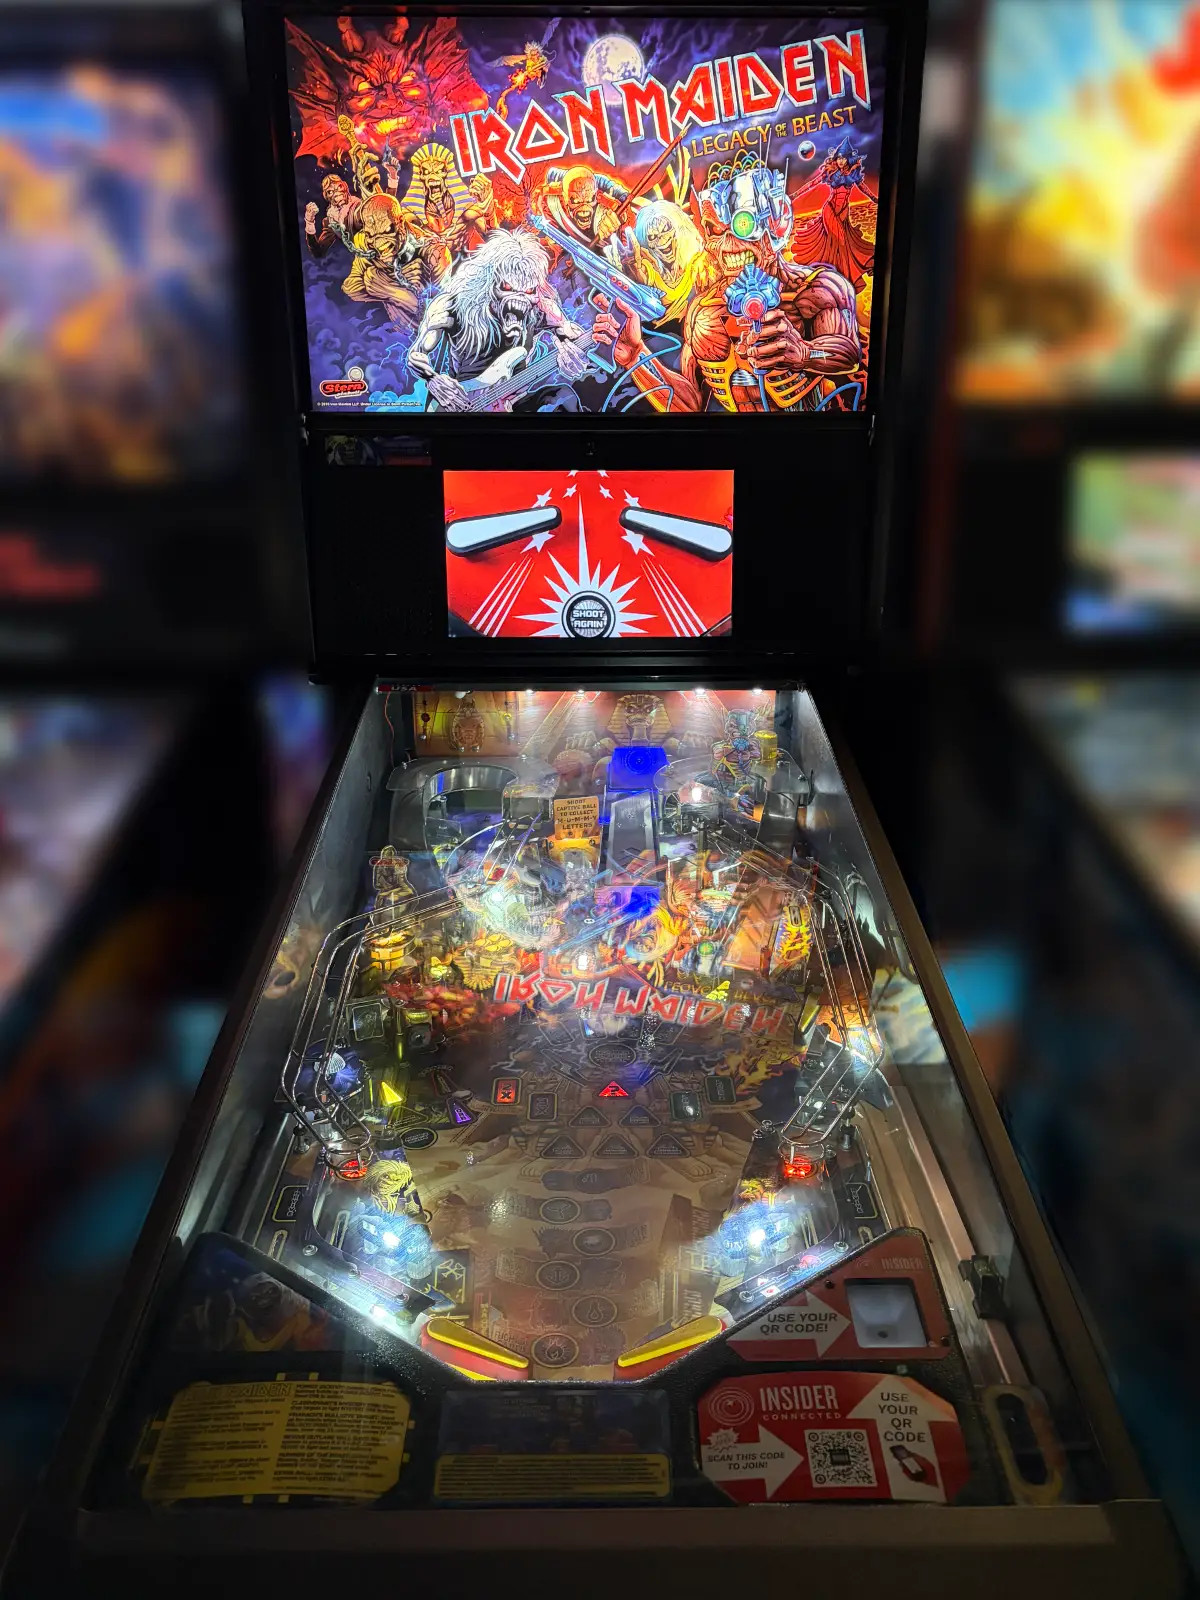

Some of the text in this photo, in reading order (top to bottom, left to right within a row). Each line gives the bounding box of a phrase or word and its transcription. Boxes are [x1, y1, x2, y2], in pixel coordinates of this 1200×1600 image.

[450, 29, 871, 186] IRON MAIDEN
[691, 124, 771, 158] LEGACY
[775, 123, 787, 132] OF
[791, 105, 857, 137] BEAST
[324, 382, 362, 393] Stern
[573, 610, 604, 618] SHOOT
[574, 620, 603, 628] AGAIN
[562, 822, 592, 830] LETTERS
[881, 1257, 923, 1269] INSIDER
[767, 1312, 838, 1323] USE YOUR
[760, 1323, 828, 1335] QR CODE!
[759, 1385, 839, 1411] INSIDER
[880, 1392, 909, 1402] USE
[878, 1404, 918, 1415] YOUR
[762, 1412, 841, 1421] CONNECTED
[891, 1417, 912, 1430] QR
[883, 1430, 926, 1442] CODE
[707, 1452, 785, 1462] SCAN THIS CODE
[742, 1462, 768, 1470] JOIN!
